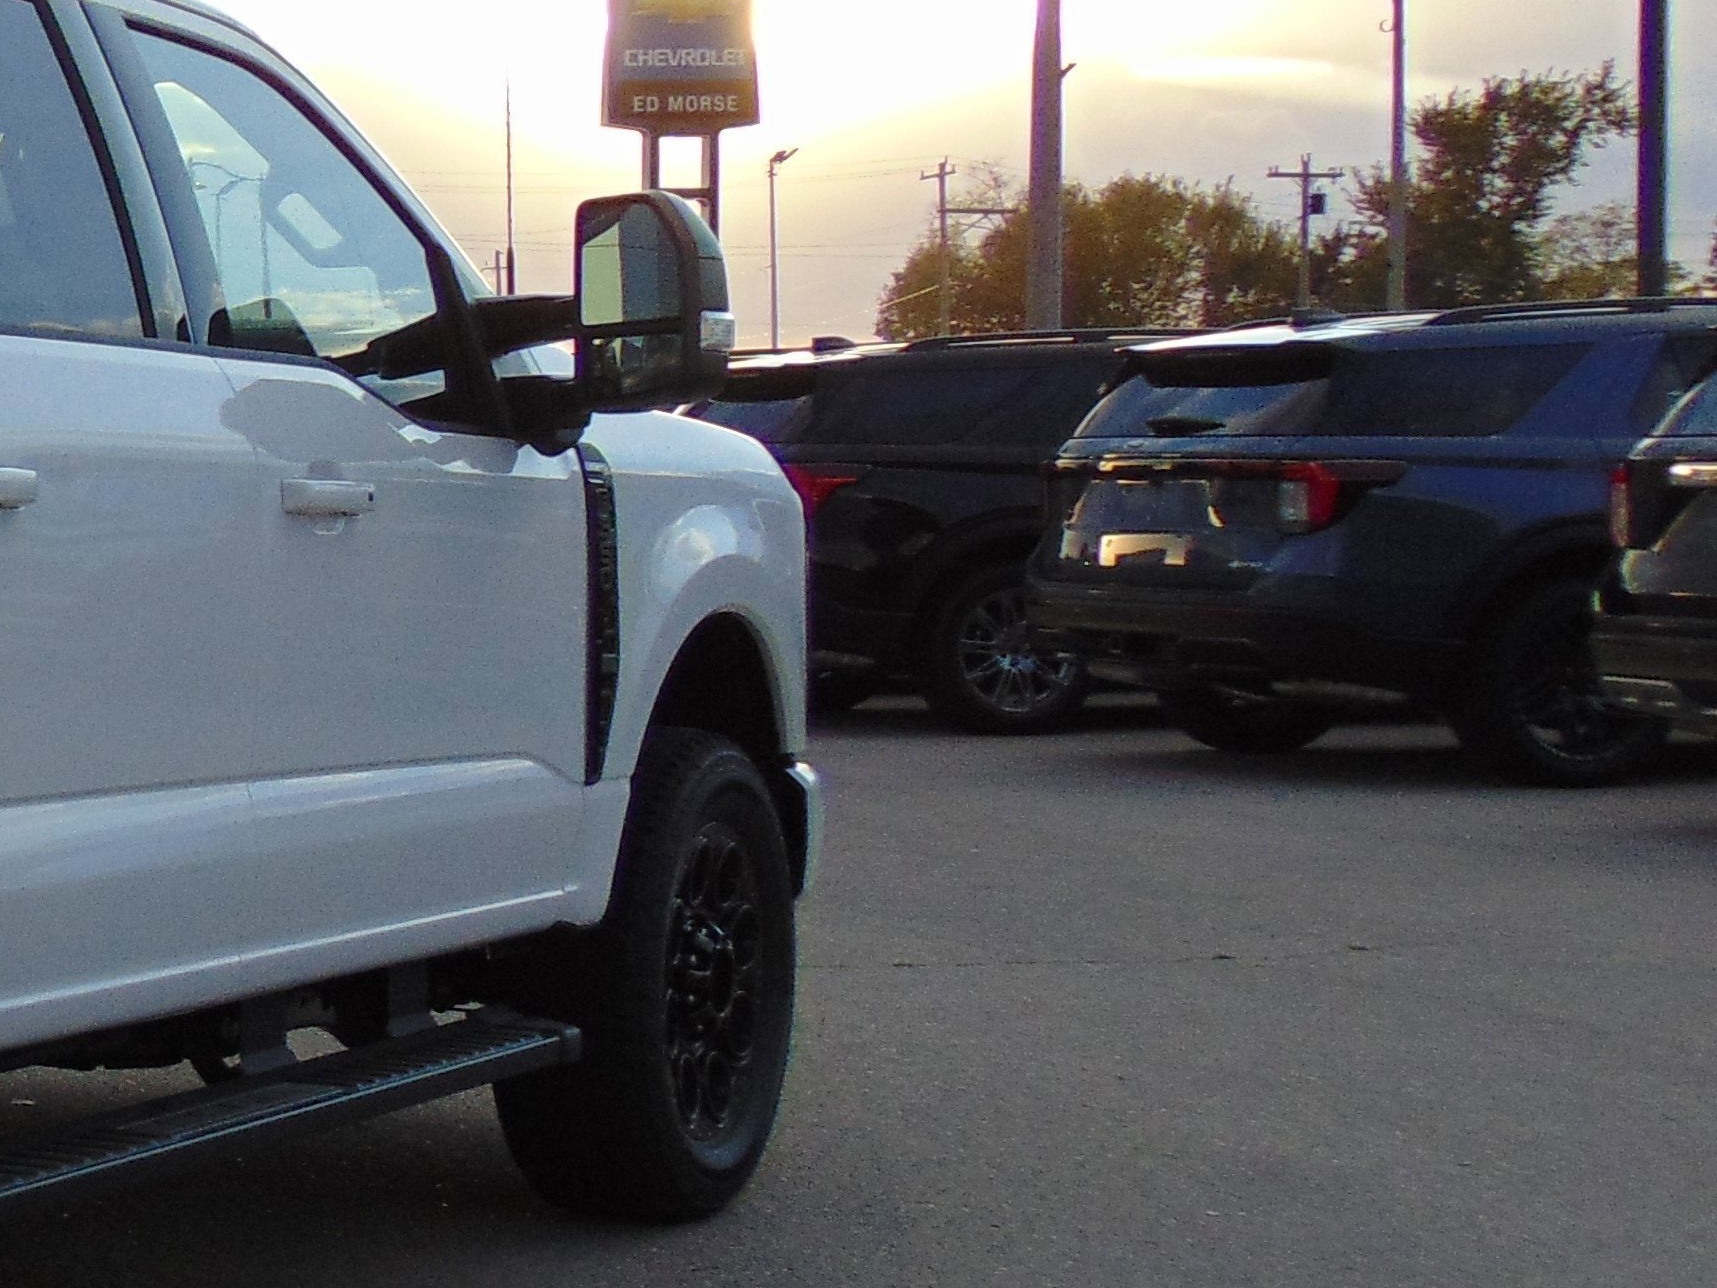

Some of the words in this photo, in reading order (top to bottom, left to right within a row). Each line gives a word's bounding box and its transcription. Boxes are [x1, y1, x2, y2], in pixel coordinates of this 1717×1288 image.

[623, 48, 746, 68] CHEVROLET
[632, 95, 660, 113] ED
[667, 95, 740, 113] MORSE
